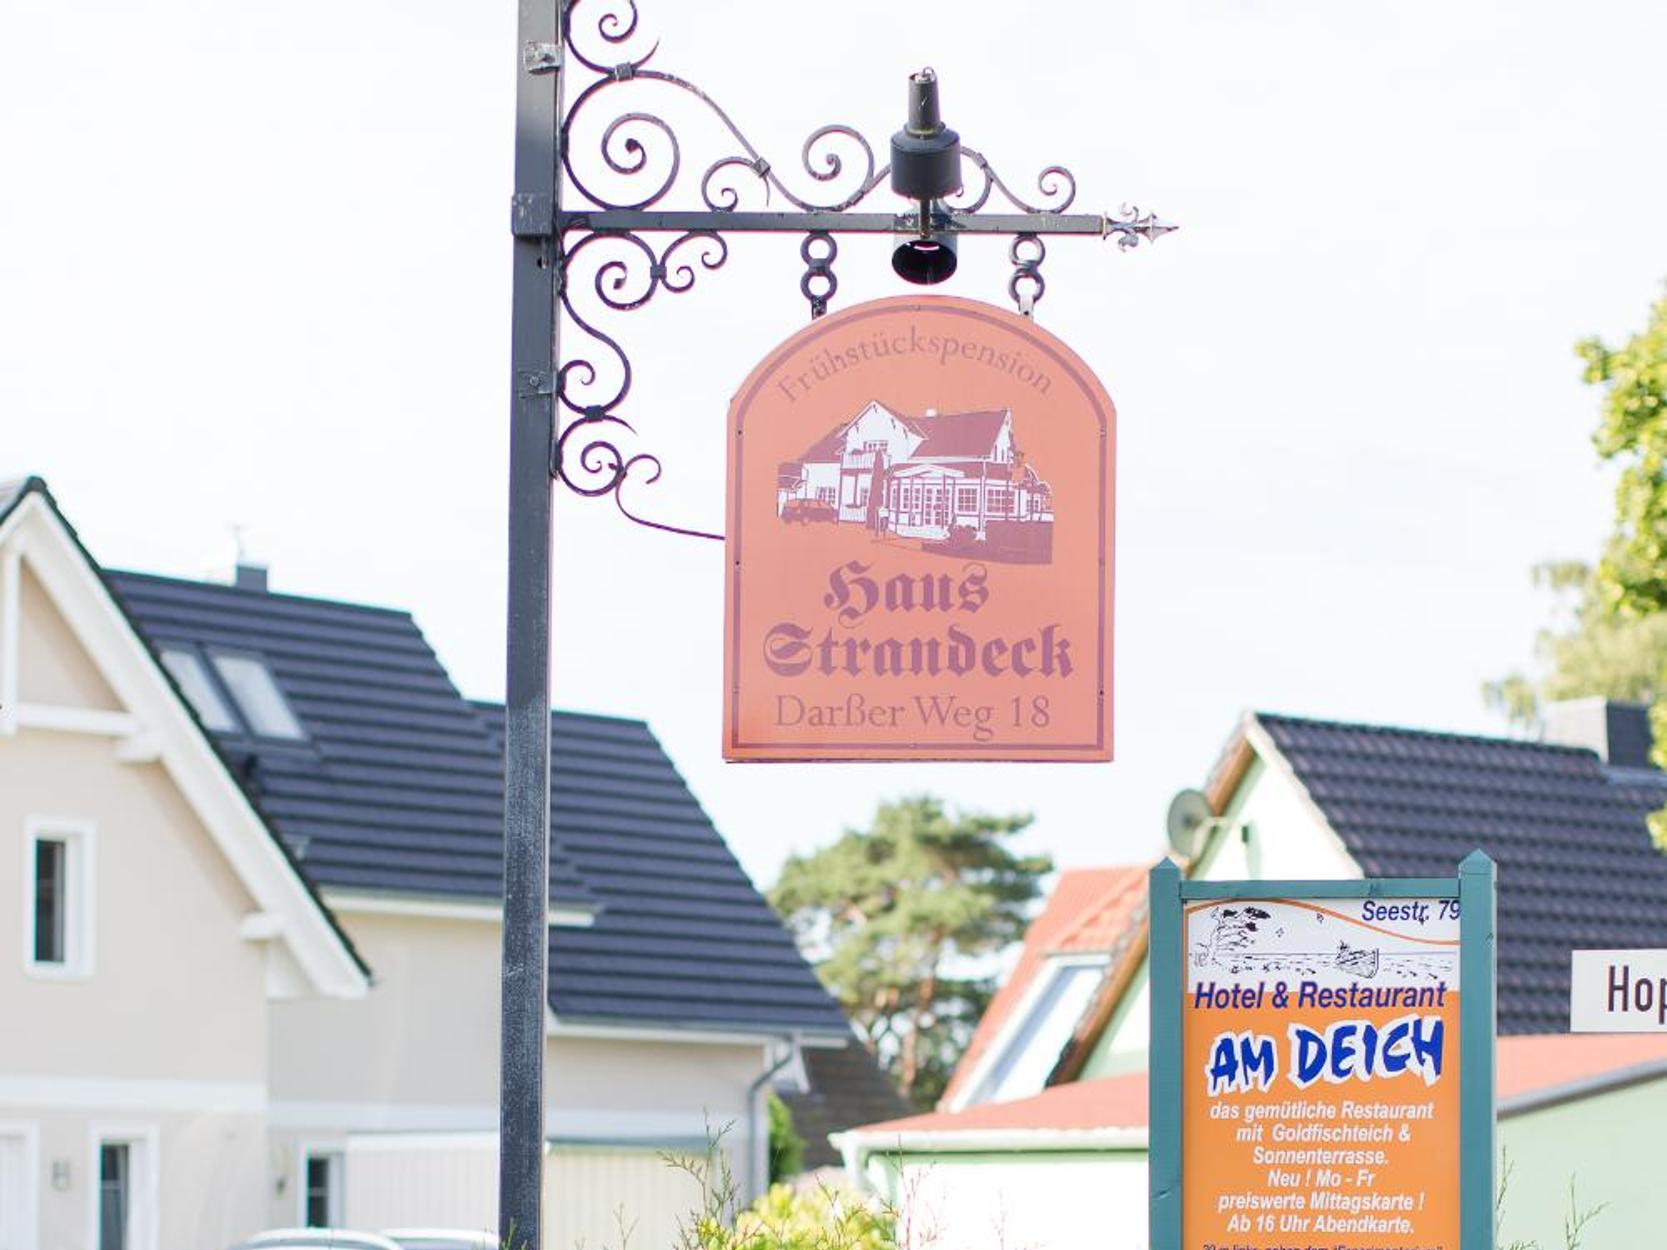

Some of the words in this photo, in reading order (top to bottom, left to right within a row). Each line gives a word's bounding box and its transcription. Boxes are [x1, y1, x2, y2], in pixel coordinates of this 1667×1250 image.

[777, 324, 1053, 404] Frühstückspension
[823, 560, 990, 629] Haus
[763, 622, 1074, 679] Strandeck
[774, 693, 905, 729] Darßer
[912, 695, 994, 743] Weg
[1011, 695, 1051, 729] 18
[1362, 901, 1430, 922] Seestr.
[1438, 901, 1461, 921] 79
[1194, 982, 1265, 1009] Hotel
[1272, 981, 1289, 1008] &
[1298, 981, 1447, 1008] Restaurant
[1210, 1036, 1275, 1092] AM
[1295, 1018, 1445, 1084] DEICH
[1210, 1101, 1239, 1119] das
[1244, 1101, 1336, 1122] gemütliche
[1341, 1101, 1434, 1119] Restaurant
[1236, 1125, 1263, 1141] mit
[1271, 1123, 1393, 1142] Goldfischteich
[1398, 1124, 1411, 1142] &
[1253, 1147, 1388, 1165] Sonnenterrasse.
[1267, 1169, 1300, 1187] Neu
[1316, 1169, 1342, 1187] Mo
[1356, 1169, 1375, 1187] Fr
[1218, 1192, 1305, 1213] preiswerte
[1310, 1192, 1414, 1214] Mittagskarte
[1227, 1215, 1251, 1233] Ab
[1256, 1216, 1275, 1233] 16
[1279, 1215, 1311, 1233] Uhr
[1313, 1215, 1415, 1234] Abendkarte.
